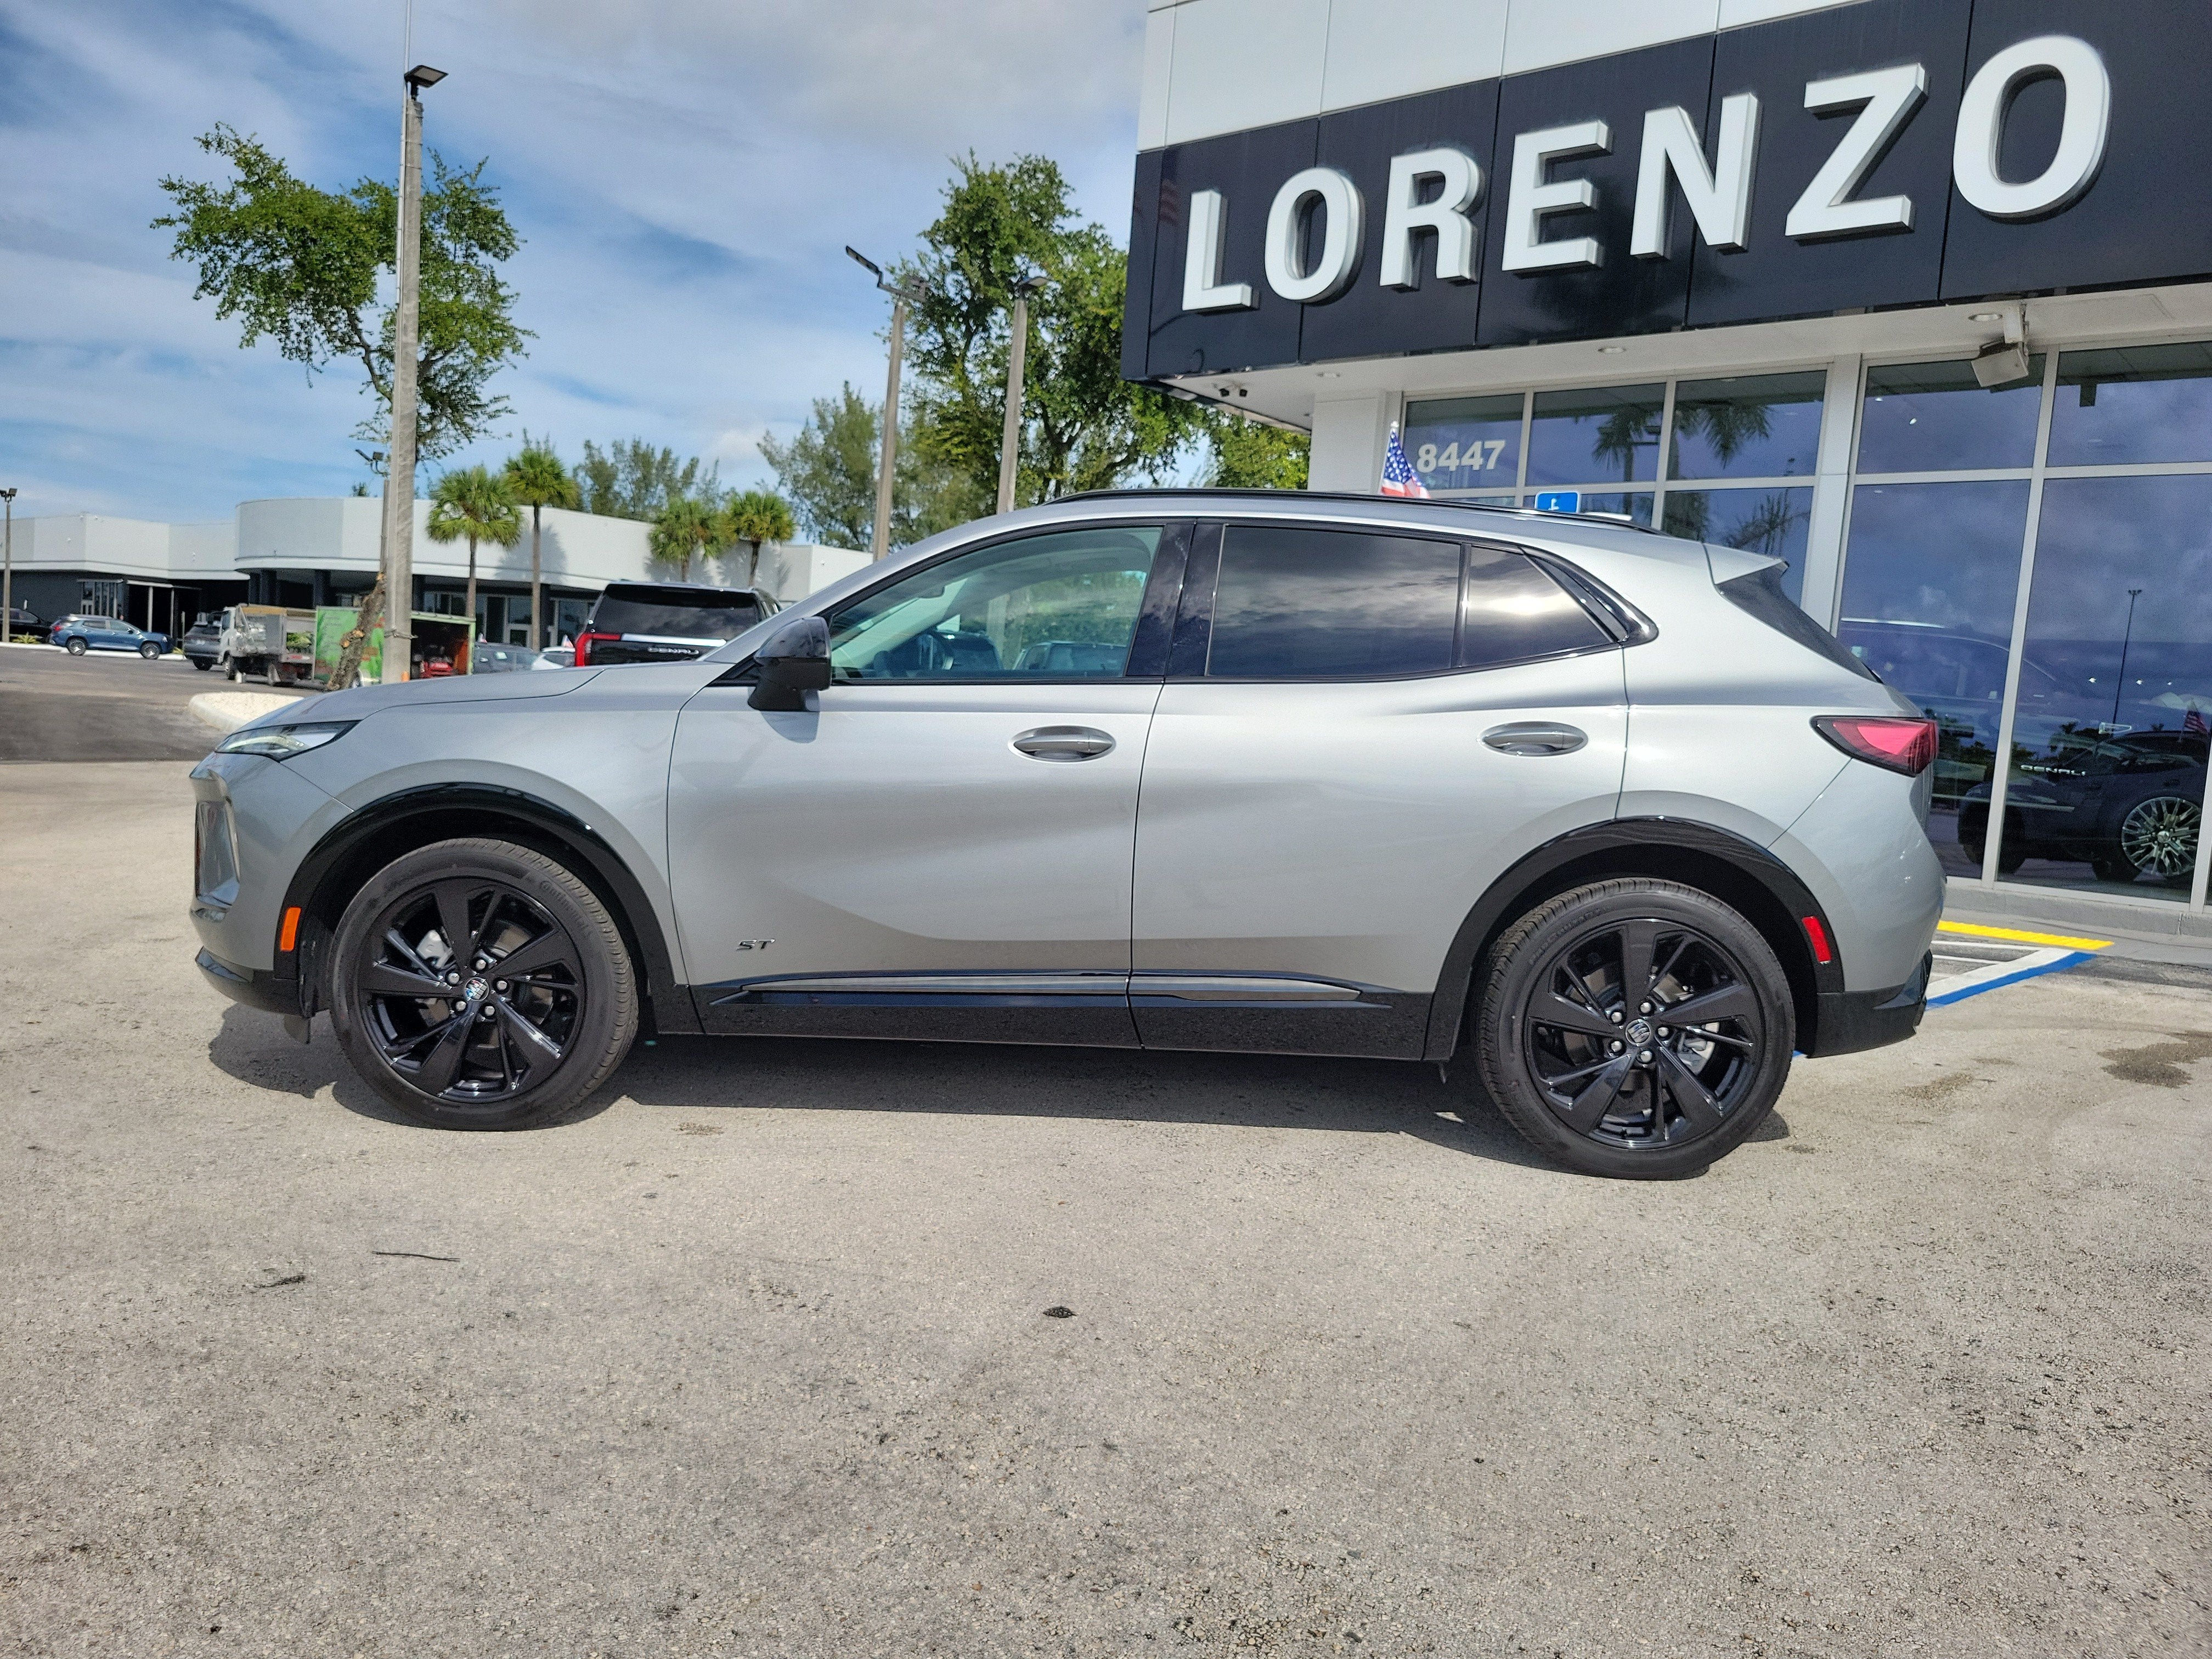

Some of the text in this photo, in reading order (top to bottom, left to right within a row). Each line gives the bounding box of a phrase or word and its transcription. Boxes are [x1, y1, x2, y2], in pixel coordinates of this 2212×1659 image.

[1181, 34, 2112, 314] LORENZO
[1413, 439, 1505, 473] 8447
[2020, 764, 2086, 776] DENALI
[736, 938, 776, 951] ST
